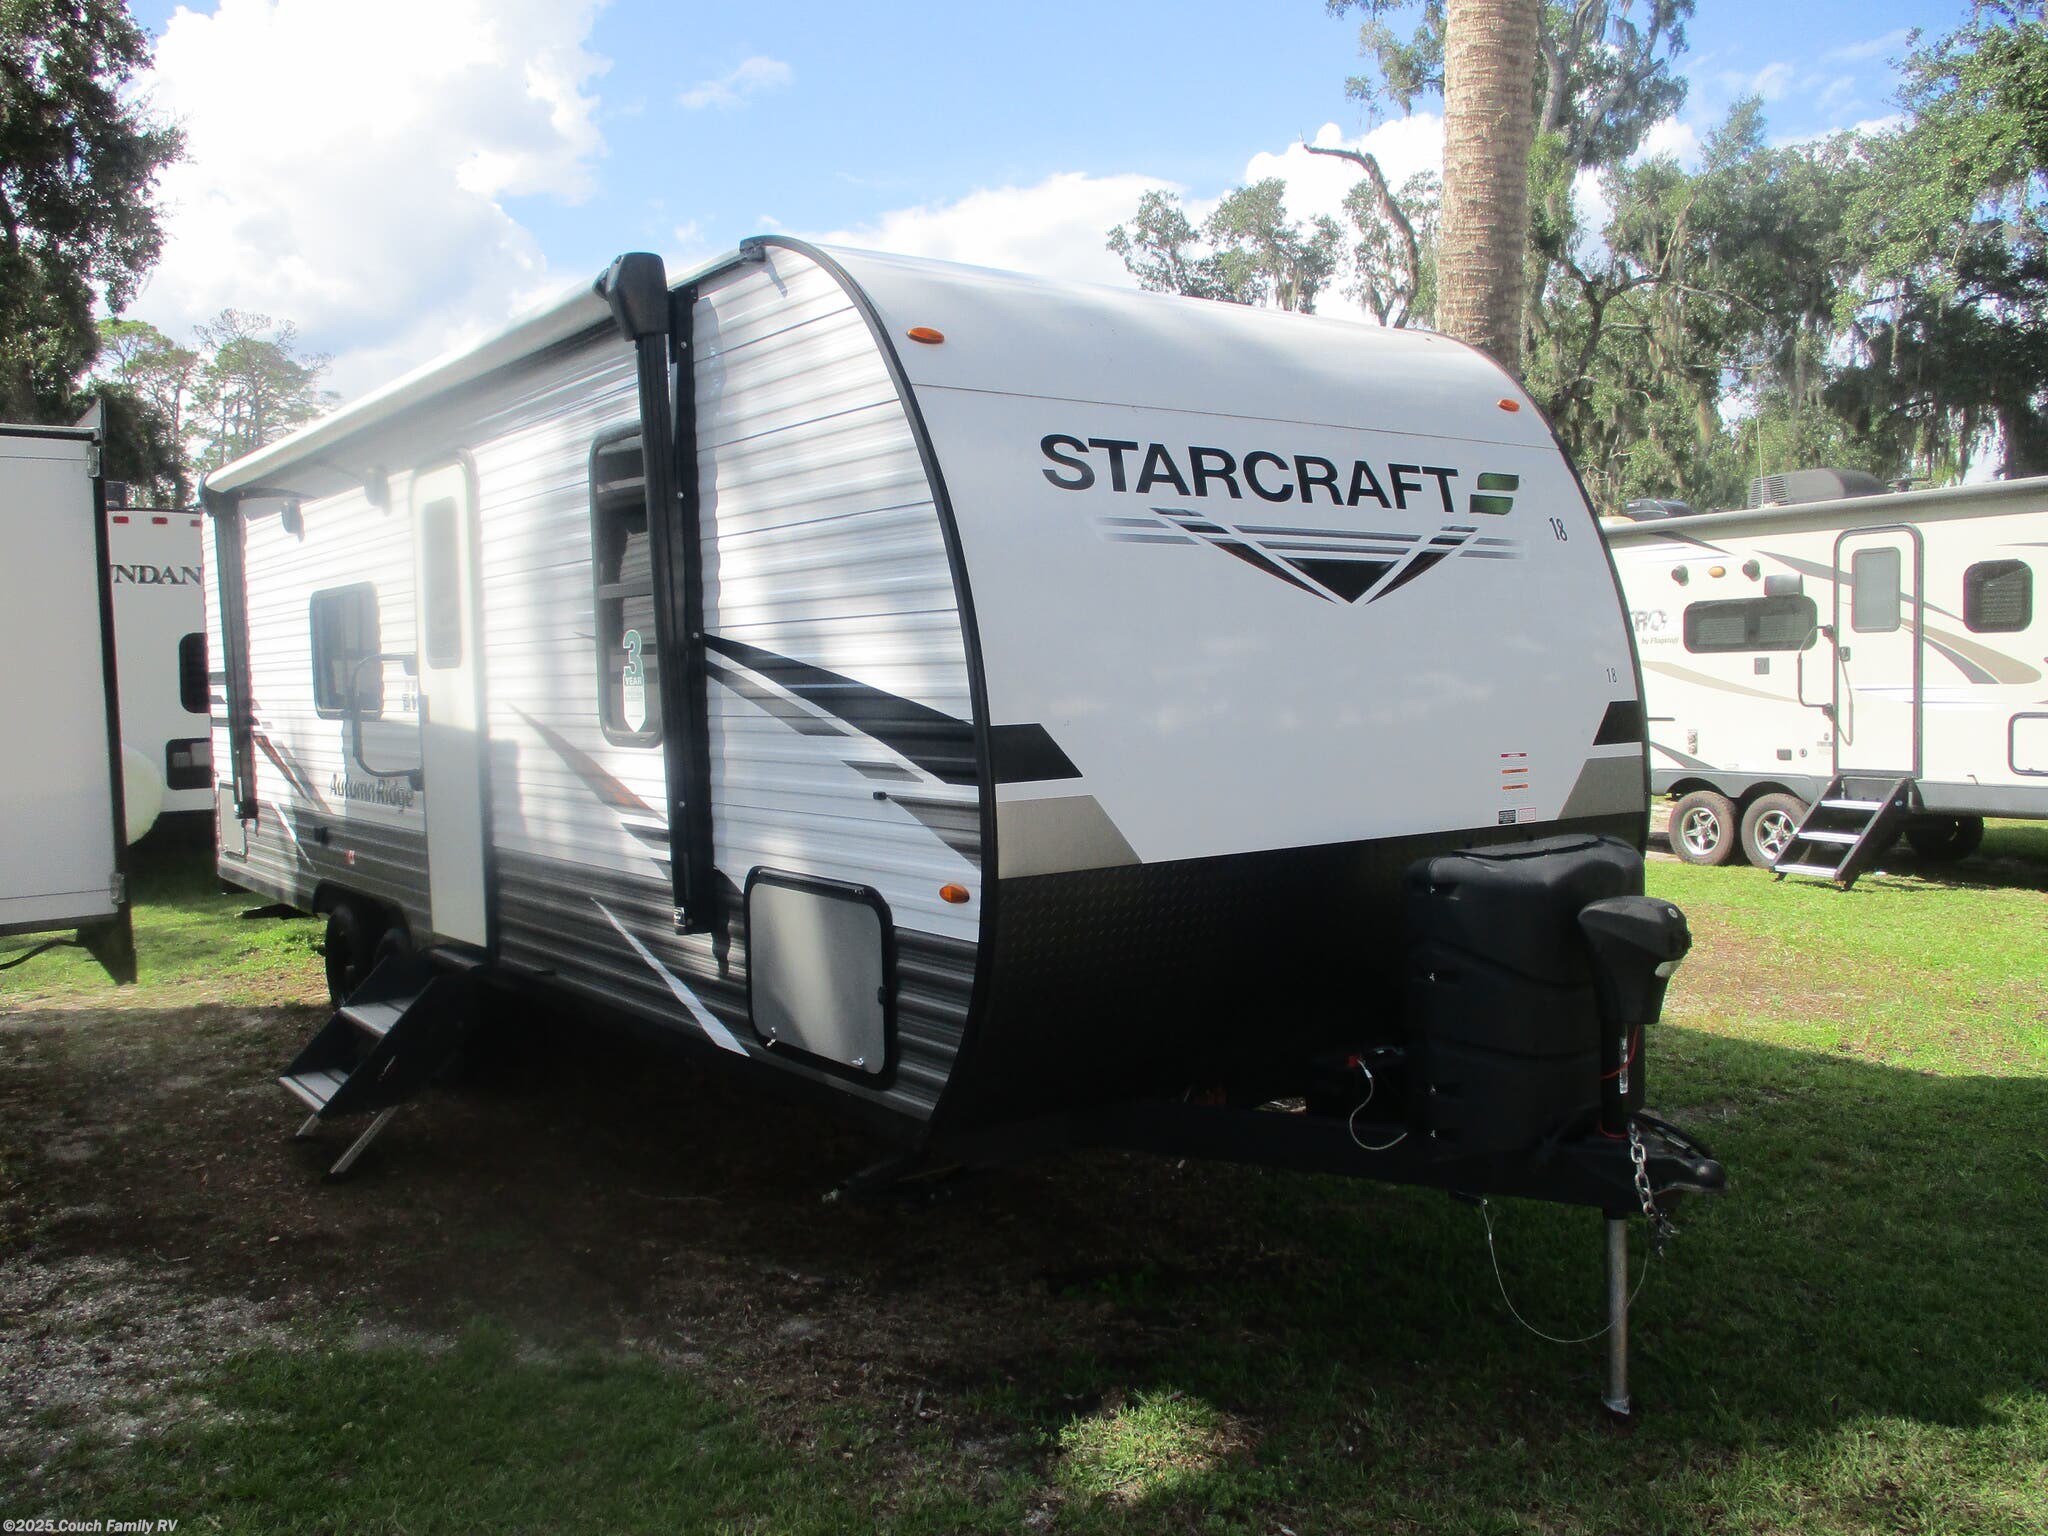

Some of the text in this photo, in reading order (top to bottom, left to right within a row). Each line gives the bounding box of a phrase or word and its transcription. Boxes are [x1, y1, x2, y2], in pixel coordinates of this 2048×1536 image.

[1040, 433, 1459, 514] STARCRAFT
[1549, 517, 1568, 542] 18
[623, 629, 644, 676] 3
[625, 676, 643, 686] YEAR
[1606, 667, 1618, 683] 18
